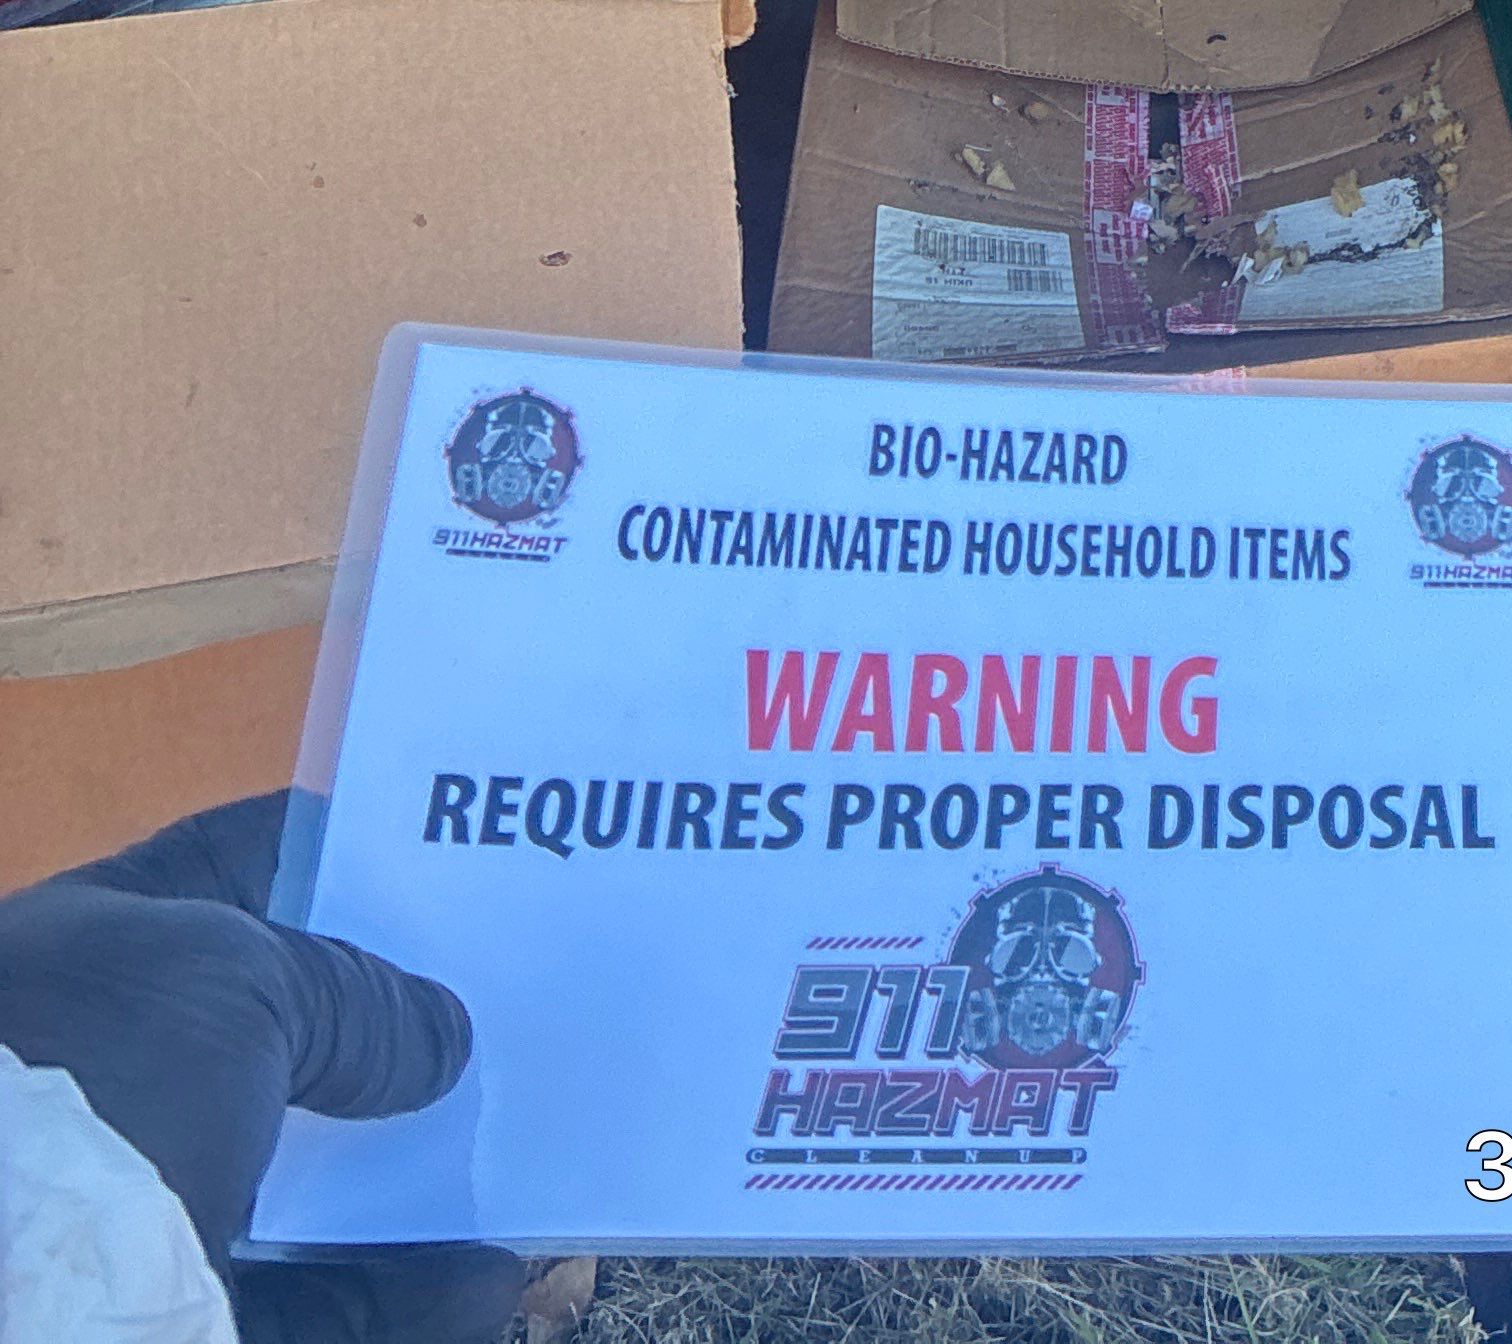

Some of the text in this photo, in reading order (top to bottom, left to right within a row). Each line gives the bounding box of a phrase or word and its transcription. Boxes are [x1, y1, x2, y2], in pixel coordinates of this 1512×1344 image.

[868, 423, 1128, 485] BIO-HAZARD
[617, 504, 1351, 582] CONTAMINATED HOUSEHOLD ITEMS
[746, 649, 1220, 754] WARNING
[422, 772, 1496, 858] REQUIRES PROPER DISPOSAL
[773, 964, 971, 1060] 911
[753, 1068, 1119, 1138] HAZMAT
